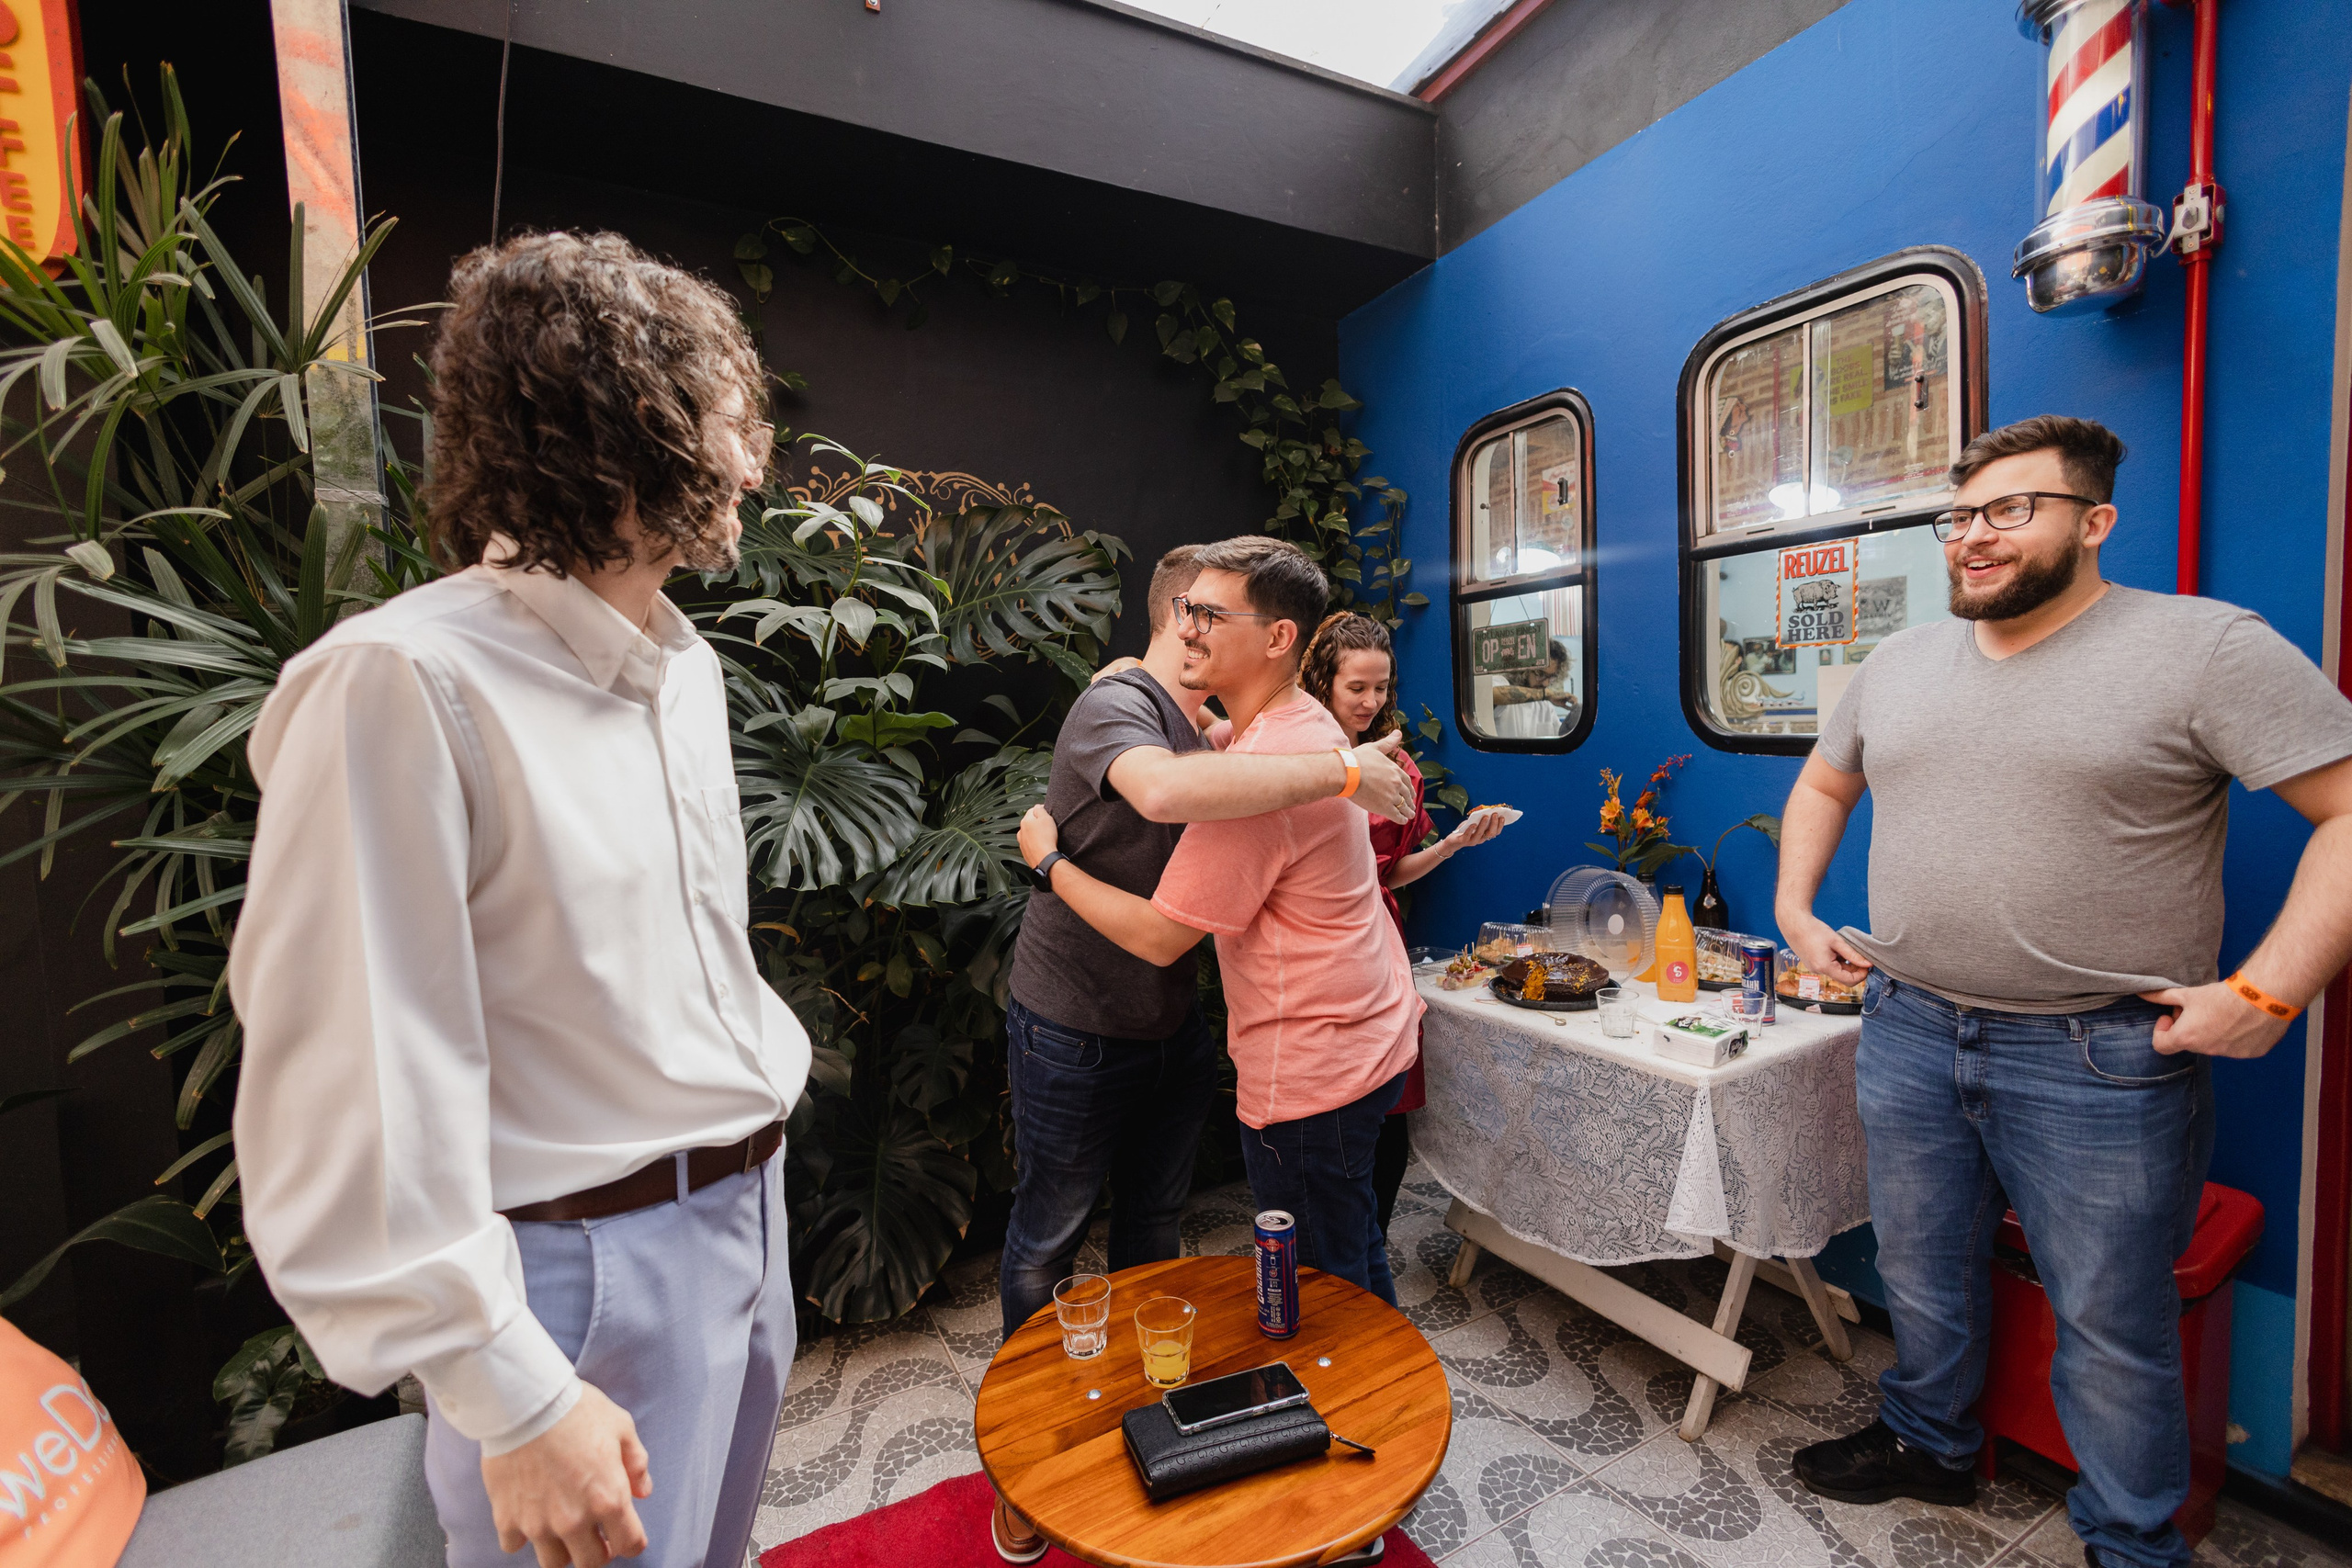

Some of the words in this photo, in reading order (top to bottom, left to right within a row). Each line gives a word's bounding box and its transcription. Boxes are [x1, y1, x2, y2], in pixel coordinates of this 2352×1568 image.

[1784, 547, 1849, 580] REUZEL
[1788, 611, 1844, 628] SOLD
[1787, 625, 1845, 642] HERE
